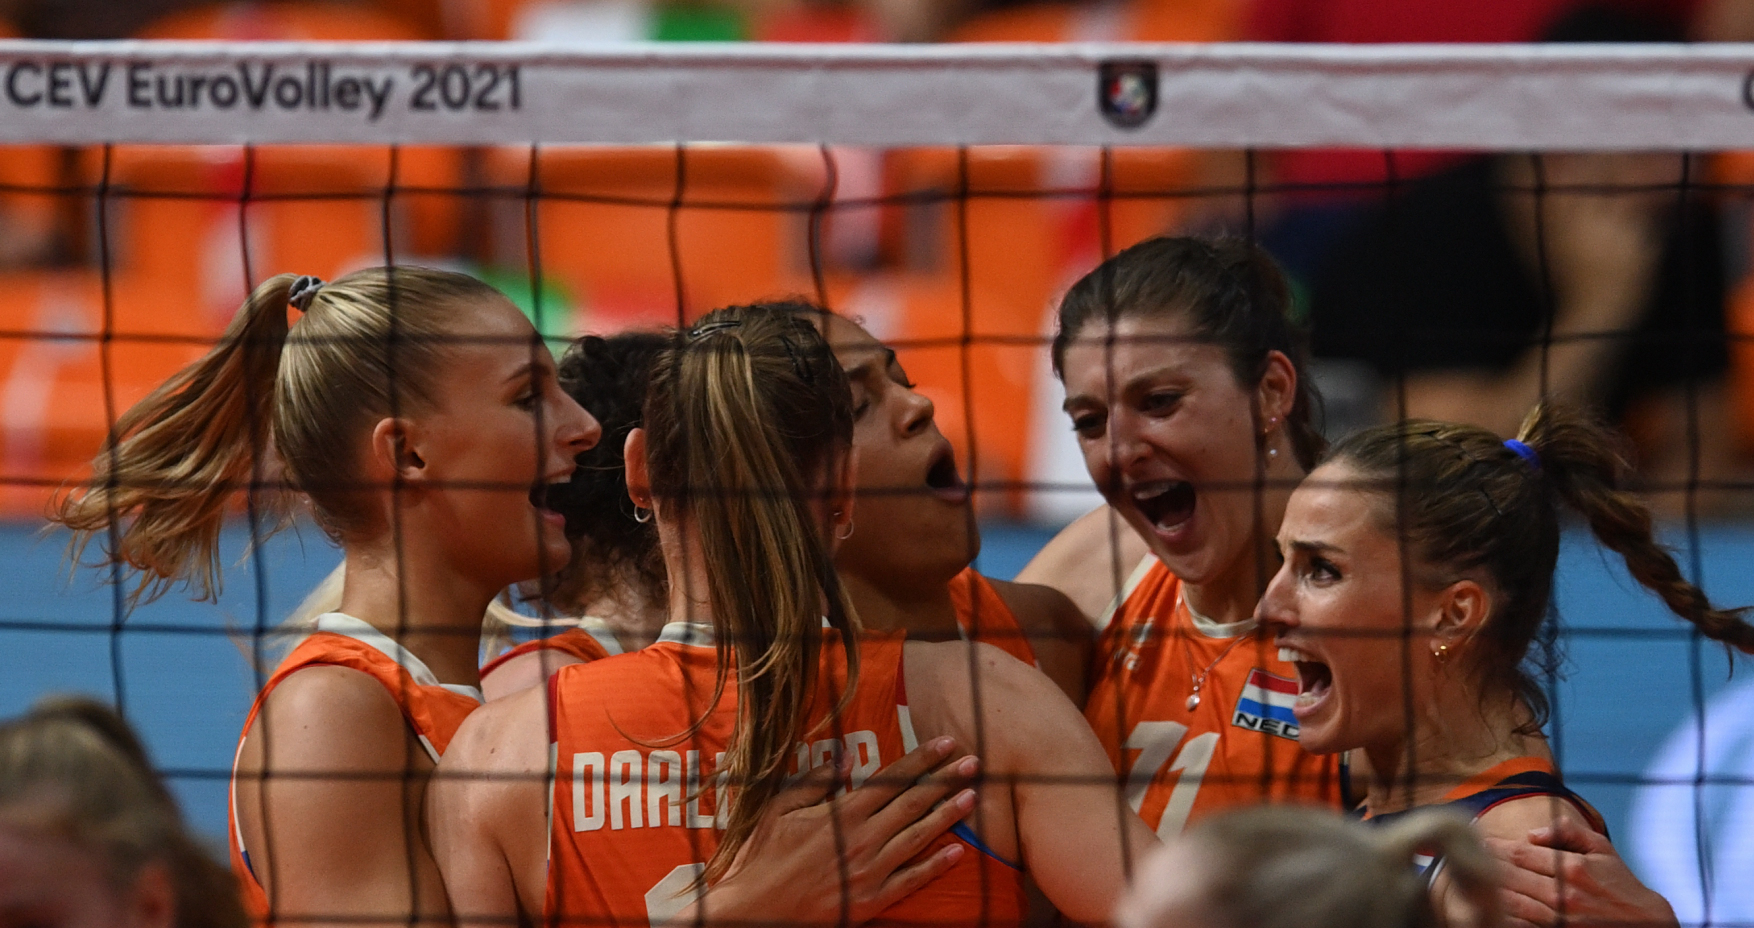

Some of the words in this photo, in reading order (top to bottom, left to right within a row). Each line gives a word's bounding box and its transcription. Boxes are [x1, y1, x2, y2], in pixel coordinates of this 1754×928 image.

[6, 62, 111, 107] CEV
[126, 62, 394, 121] EuroVolley
[409, 64, 523, 111] 2021
[573, 730, 881, 832] DAALP
